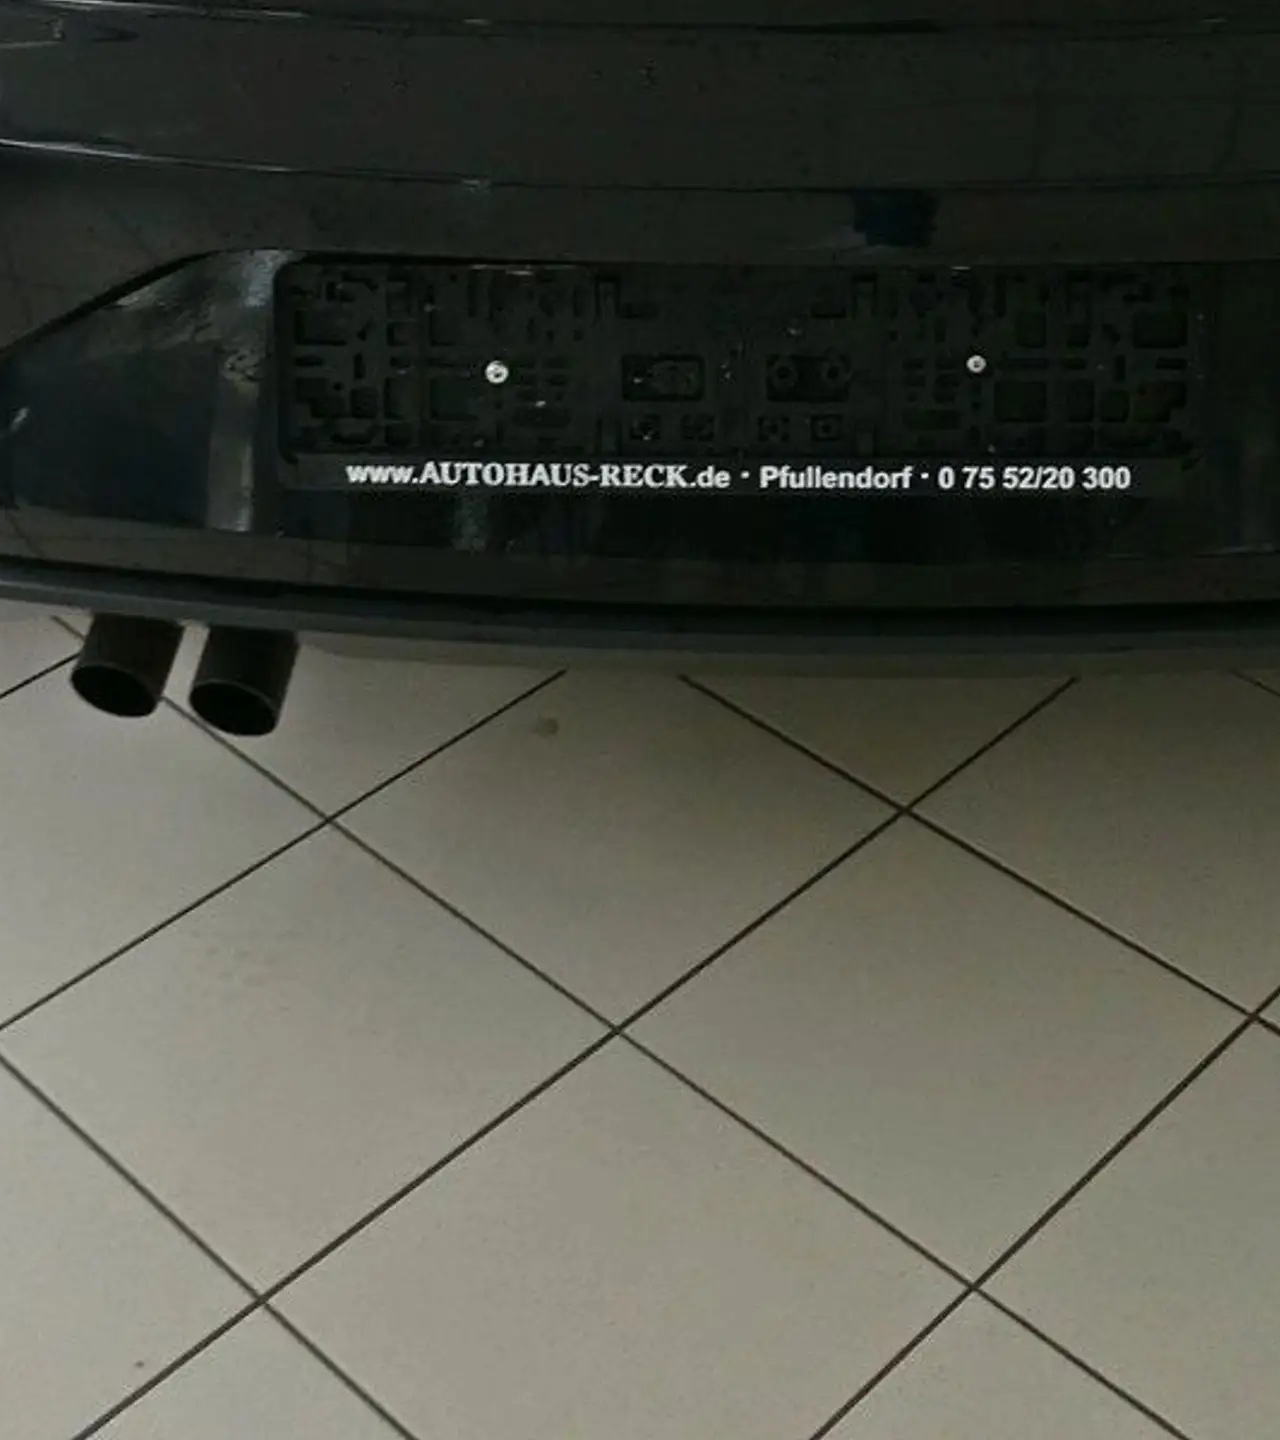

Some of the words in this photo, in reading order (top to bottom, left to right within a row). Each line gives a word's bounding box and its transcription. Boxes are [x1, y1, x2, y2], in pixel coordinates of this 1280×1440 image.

[345, 460, 731, 489] www.AUTOHAUS-RECK.de
[758, 464, 914, 490] Pfullendorf
[937, 465, 955, 490] 0
[961, 465, 996, 490] 75
[1002, 465, 1076, 490] 52/20
[1081, 465, 1132, 490] 300
